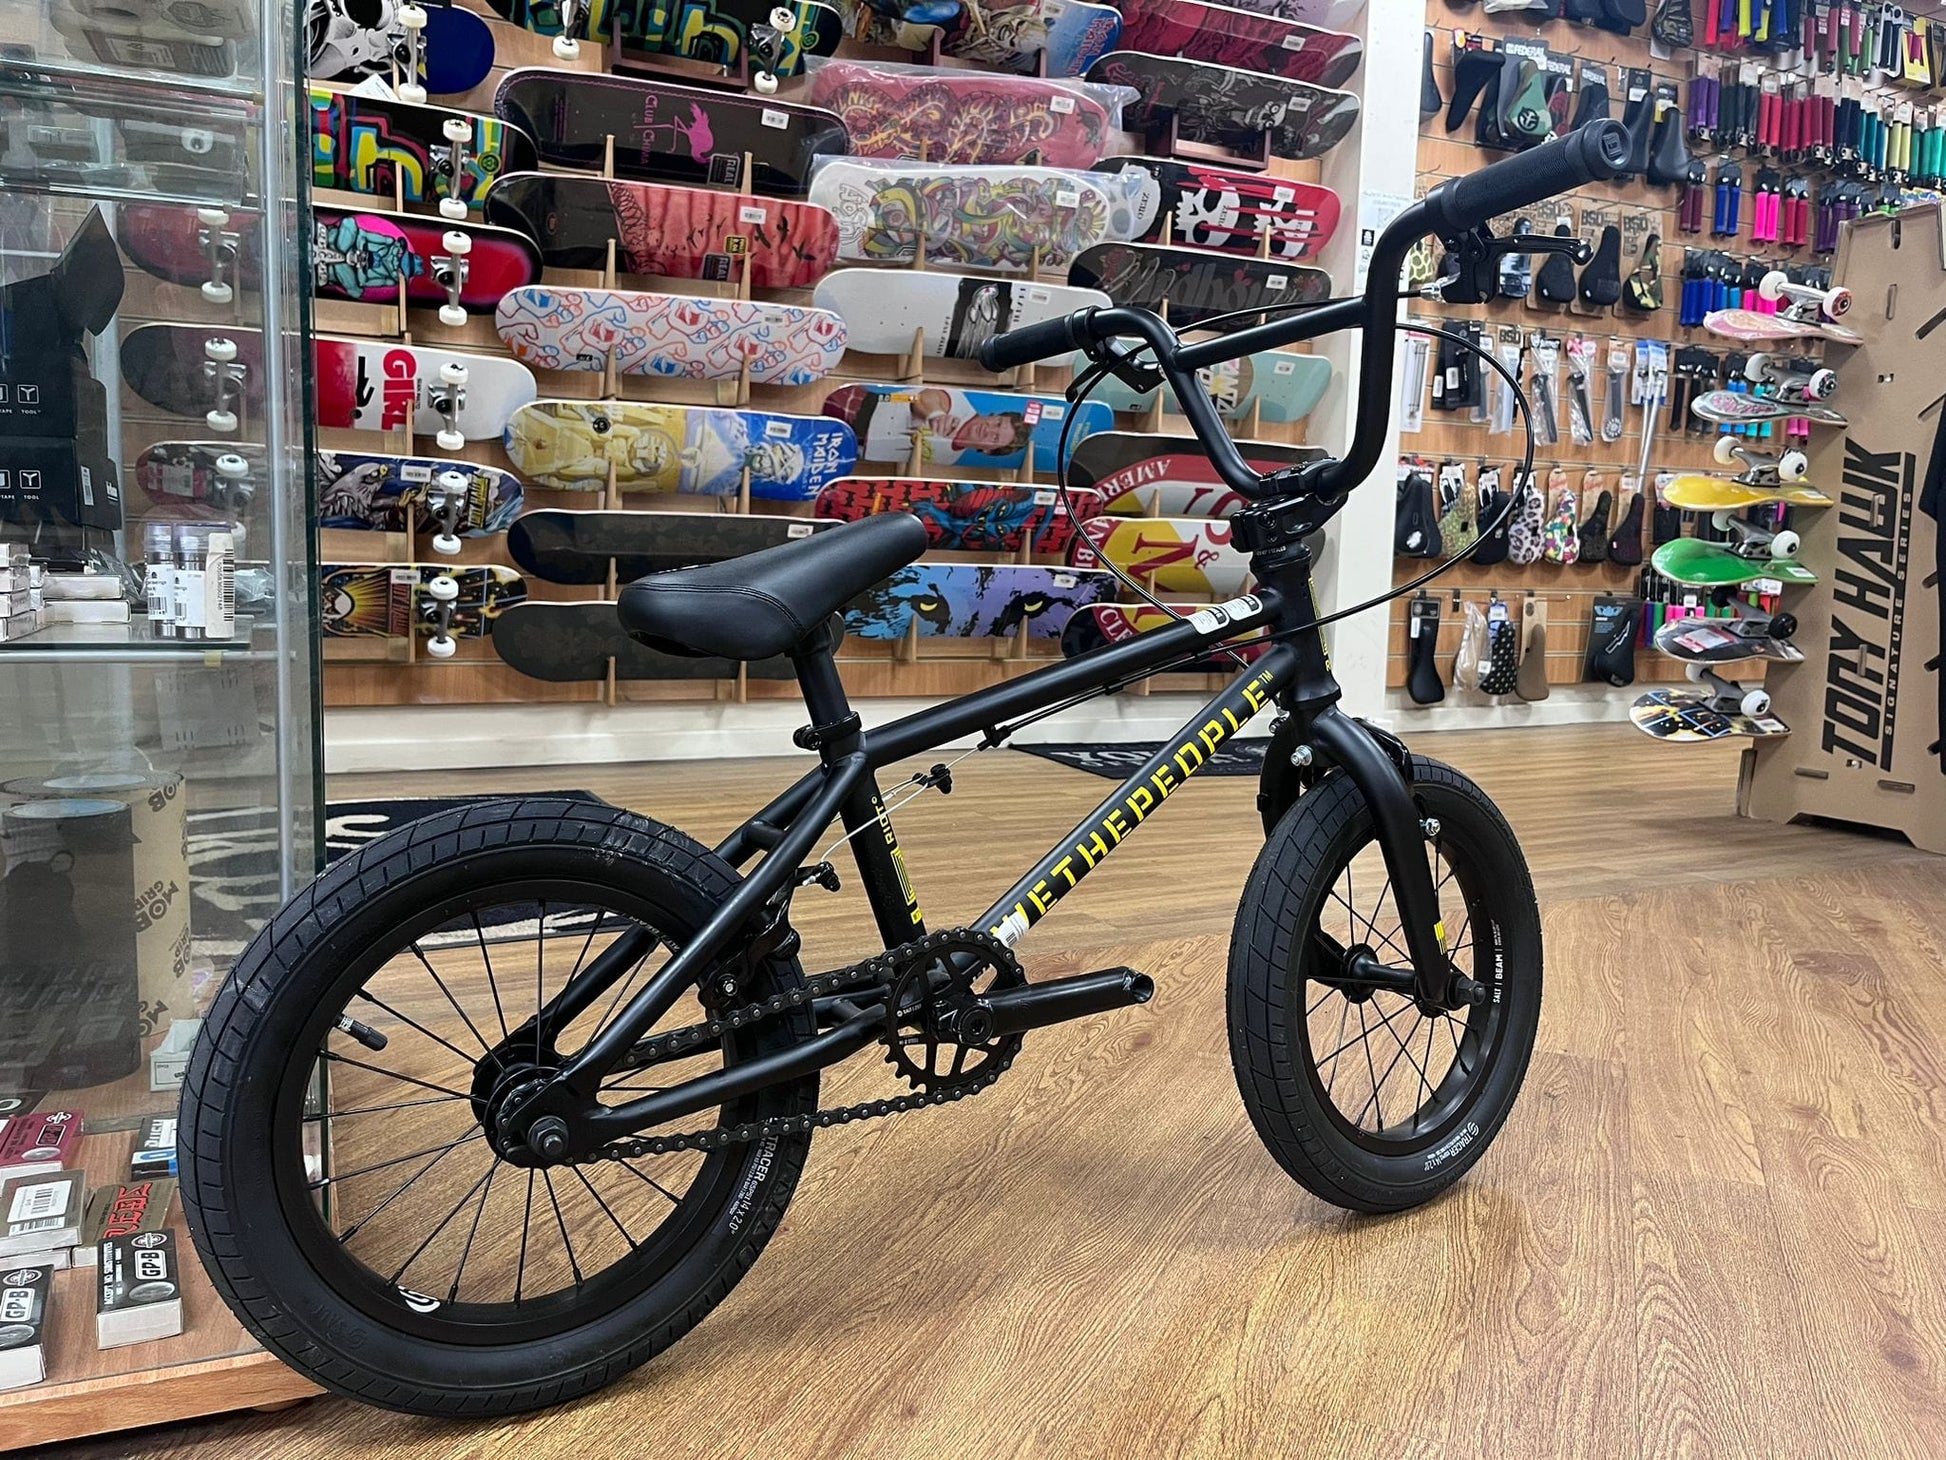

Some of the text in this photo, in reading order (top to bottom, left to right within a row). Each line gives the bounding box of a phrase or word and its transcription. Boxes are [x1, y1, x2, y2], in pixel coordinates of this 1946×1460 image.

[725, 158, 737, 183] REAL
[1581, 209, 1604, 226] BSD
[1623, 216, 1649, 232] BSD
[716, 256, 729, 280] REAL
[803, 433, 826, 497] MAIDEN
[825, 433, 844, 474] IRON
[1832, 436, 1902, 620] HAWK
[1884, 491, 1912, 736] SIGNATURE SERIES
[1821, 614, 1886, 766] TONY
[148, 783, 178, 813] OB
[1495, 954, 1504, 980] BEAM
[1493, 988, 1502, 1004] SALT
[754, 1135, 779, 1183] TRACER
[1451, 1133, 1474, 1158] TRACER
